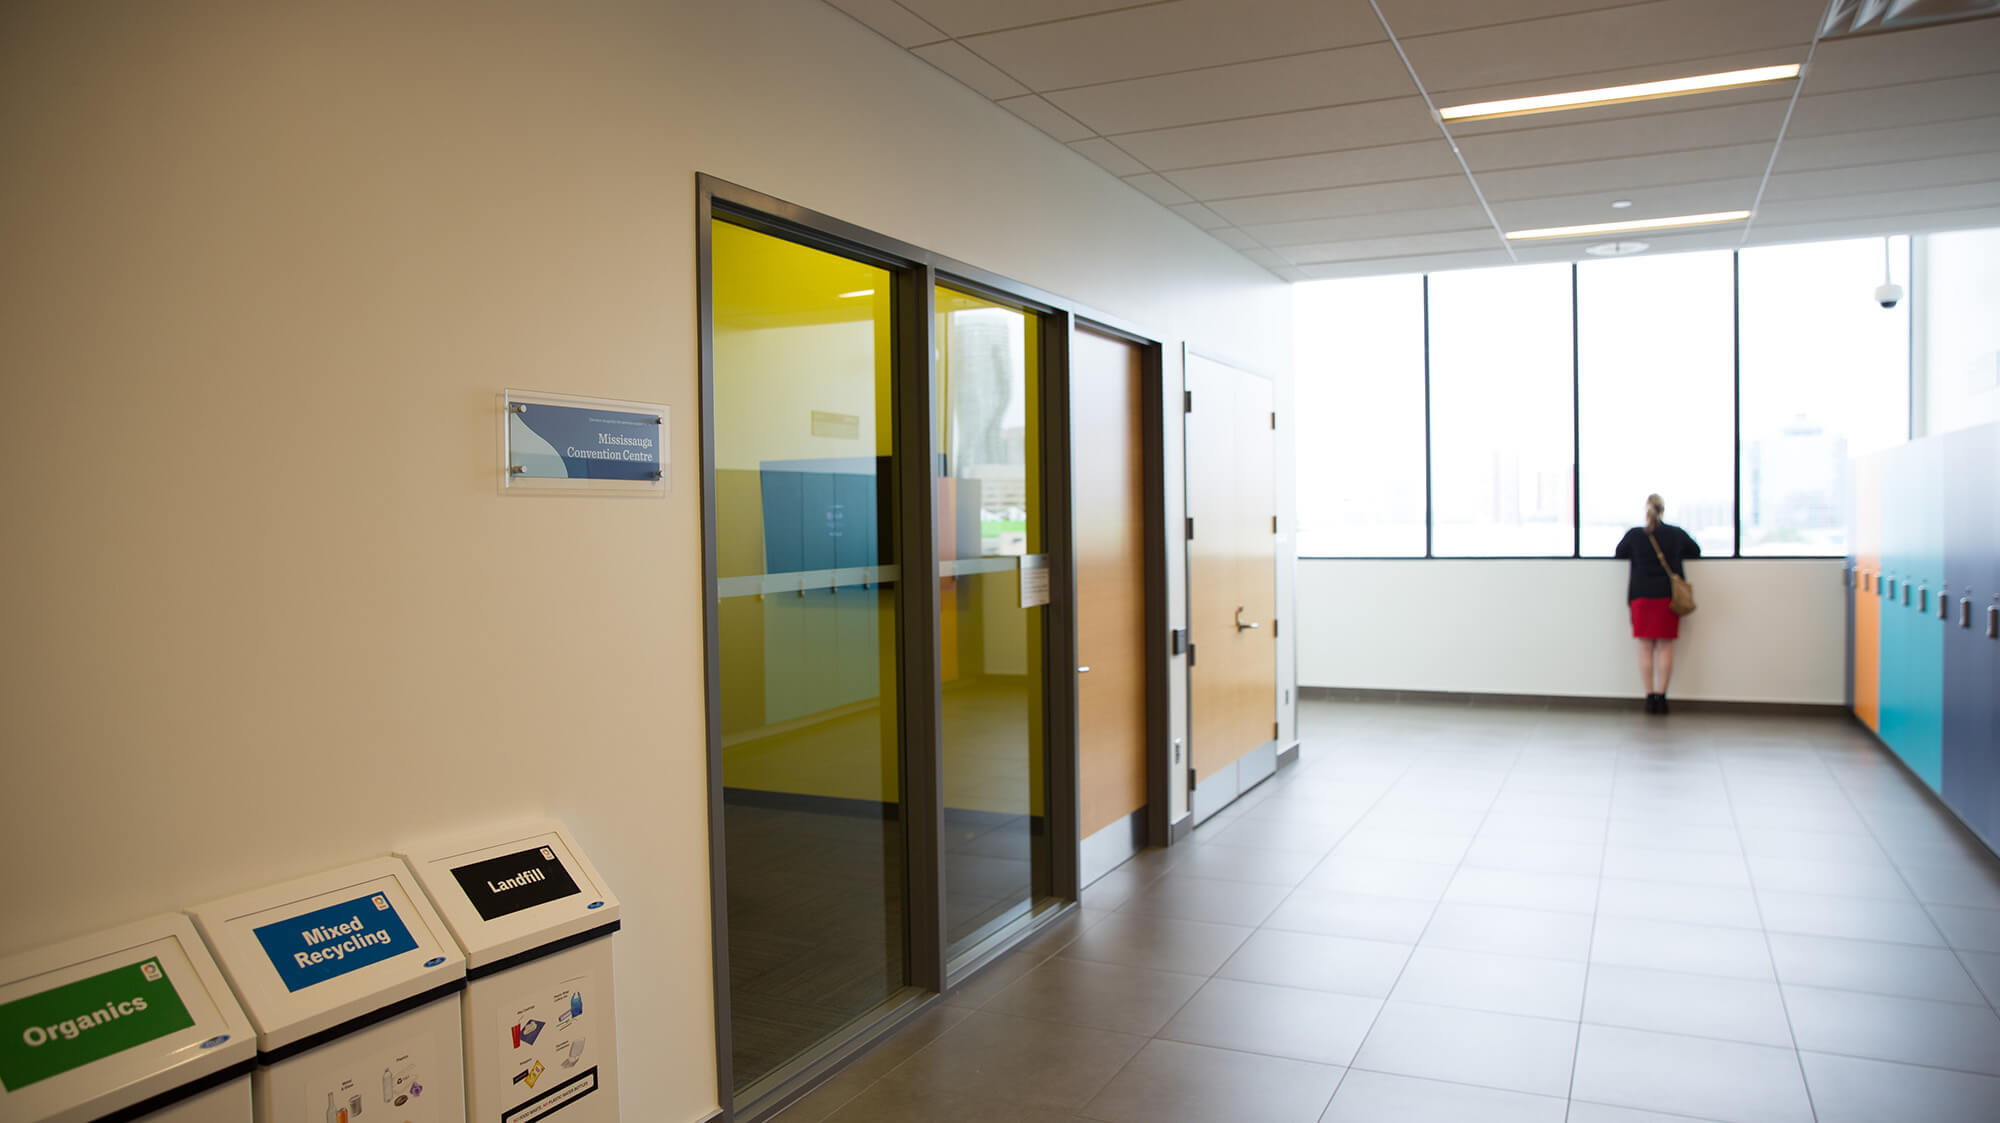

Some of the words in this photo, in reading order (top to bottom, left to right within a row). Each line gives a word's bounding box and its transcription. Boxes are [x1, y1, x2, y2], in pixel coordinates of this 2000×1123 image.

[567, 446, 622, 461] Convention
[622, 449, 653, 462] Centre
[598, 433, 653, 448] Mississauga
[487, 868, 545, 894] Landfill
[301, 915, 365, 947] Mixed
[293, 928, 392, 969] Recycling
[22, 995, 149, 1048] Organics
